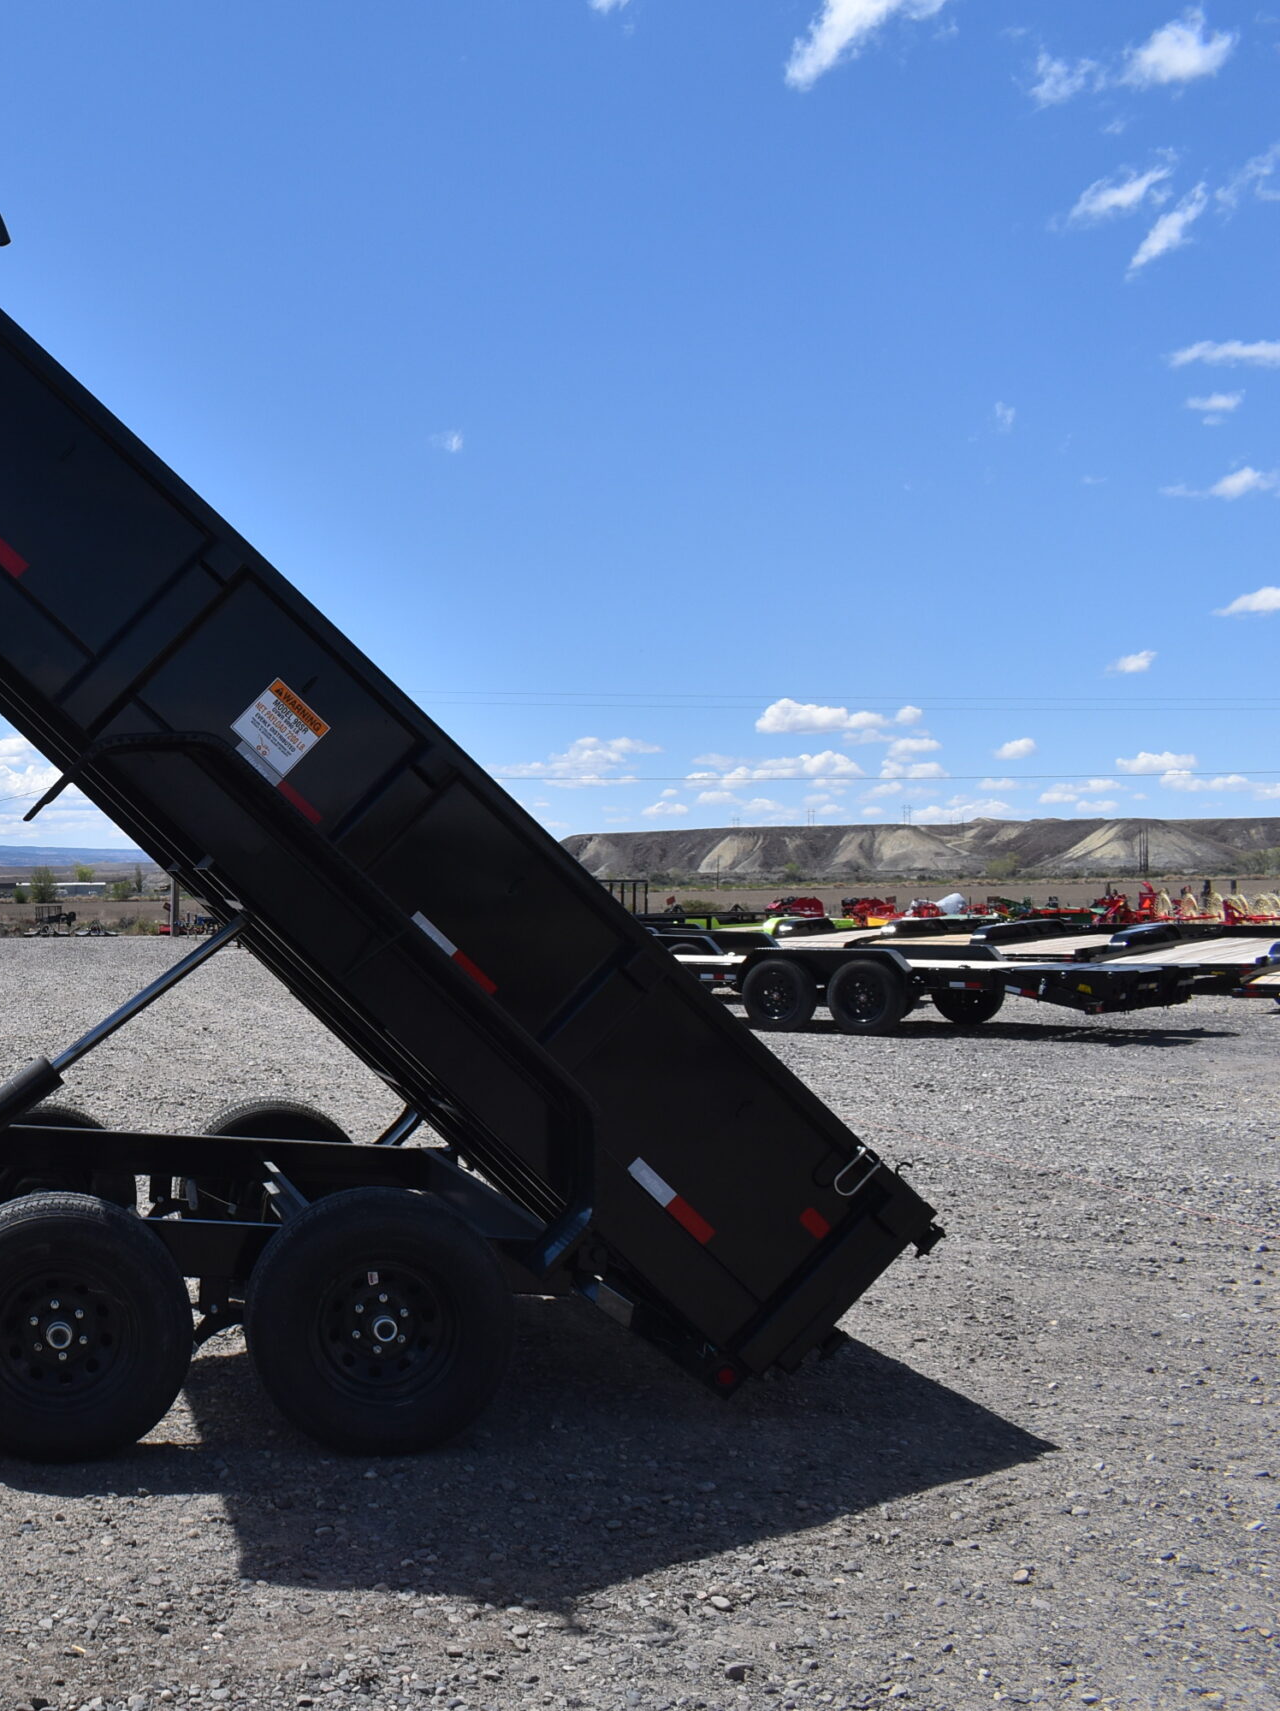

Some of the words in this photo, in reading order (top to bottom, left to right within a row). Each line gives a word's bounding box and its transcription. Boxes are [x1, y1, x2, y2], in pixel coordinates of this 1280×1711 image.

[254, 701, 267, 714] NET
[263, 710, 288, 734] PAYLOAD
[284, 730, 299, 745] 7200
[271, 698, 294, 720] MODEL
[291, 717, 309, 735] 90SR
[280, 691, 323, 732] WARNING
[253, 712, 271, 728] EVENLY
[268, 726, 296, 753] DISTRIBUTED
